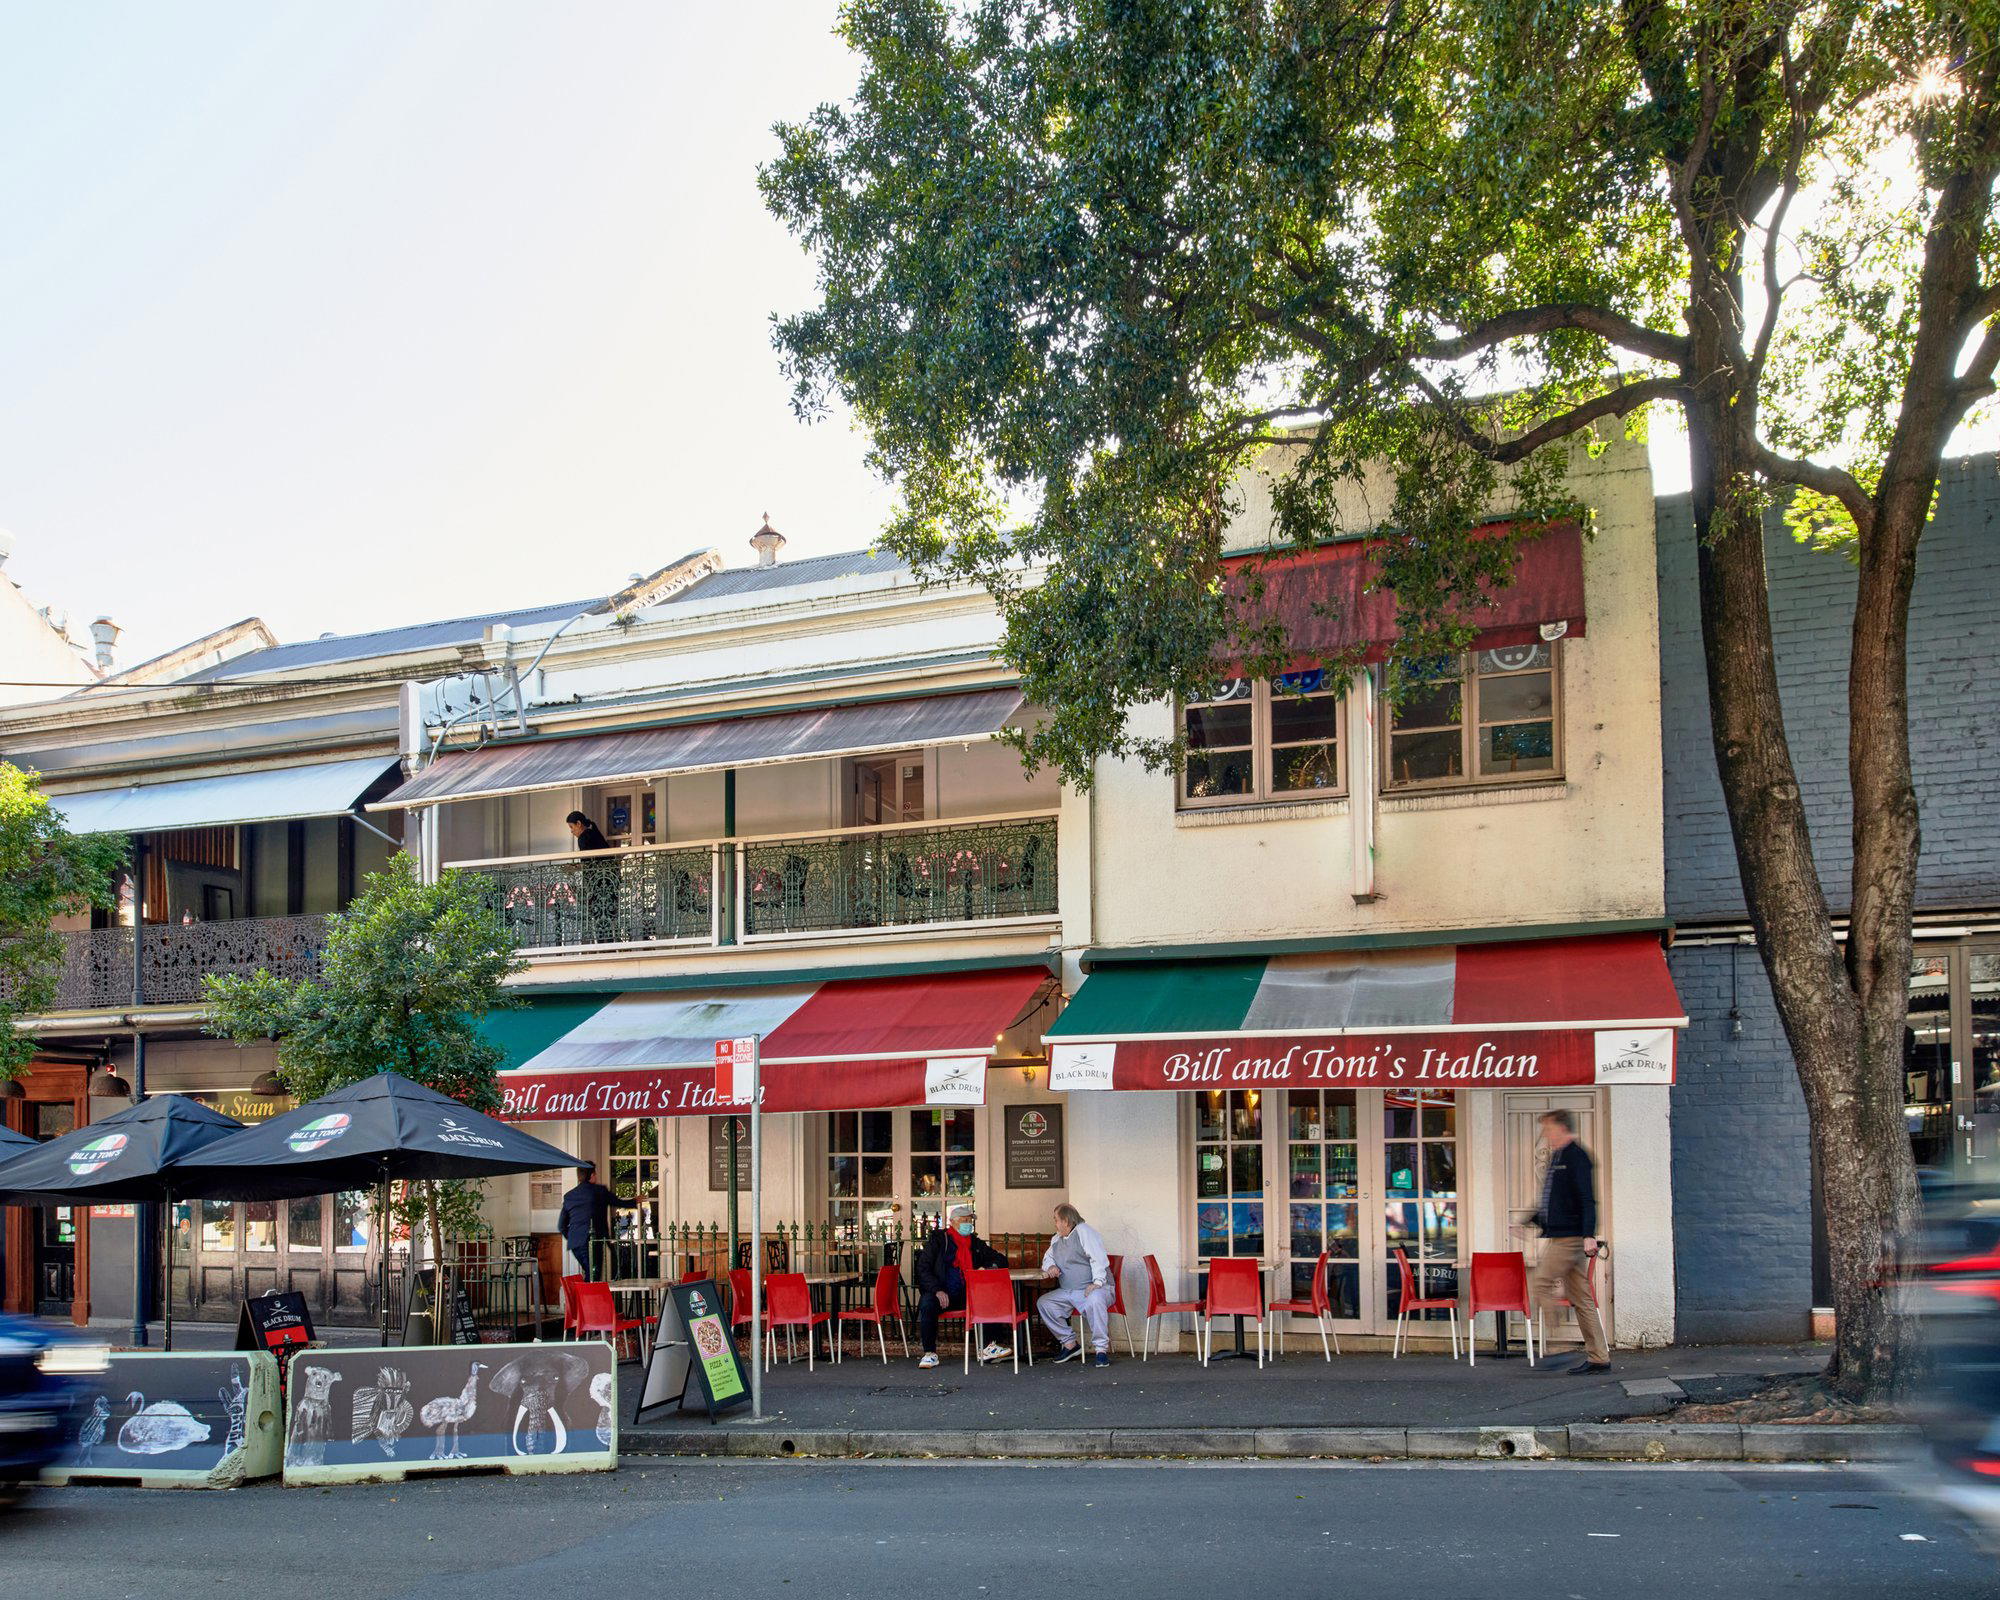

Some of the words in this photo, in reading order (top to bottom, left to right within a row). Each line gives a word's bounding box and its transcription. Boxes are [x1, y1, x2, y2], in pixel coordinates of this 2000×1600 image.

[720, 1043, 729, 1054] NO
[737, 1043, 751, 1053] BUS
[716, 1056, 734, 1064] STOPPING
[735, 1053, 753, 1062] ZONE
[1163, 1047, 1231, 1082] Bill
[1231, 1045, 1301, 1080] and
[1303, 1044, 1407, 1079] Toni's
[1414, 1042, 1539, 1079] Italian
[1601, 1060, 1635, 1073] BLACK
[1636, 1060, 1667, 1072] DRUM
[1055, 1070, 1084, 1081] BLACK
[1085, 1070, 1109, 1080] DRUM
[930, 1083, 957, 1094] BLACK
[958, 1083, 982, 1094] DRUM
[500, 1083, 546, 1114] Bill
[545, 1081, 597, 1113] and
[596, 1079, 671, 1111] Toni's
[231, 1095, 276, 1117] Siam
[289, 1131, 309, 1139] BILL
[437, 1134, 471, 1142] BLACK
[468, 1135, 505, 1148] DRUM
[70, 1152, 89, 1160] BILL
[262, 1315, 283, 1329] BLACK
